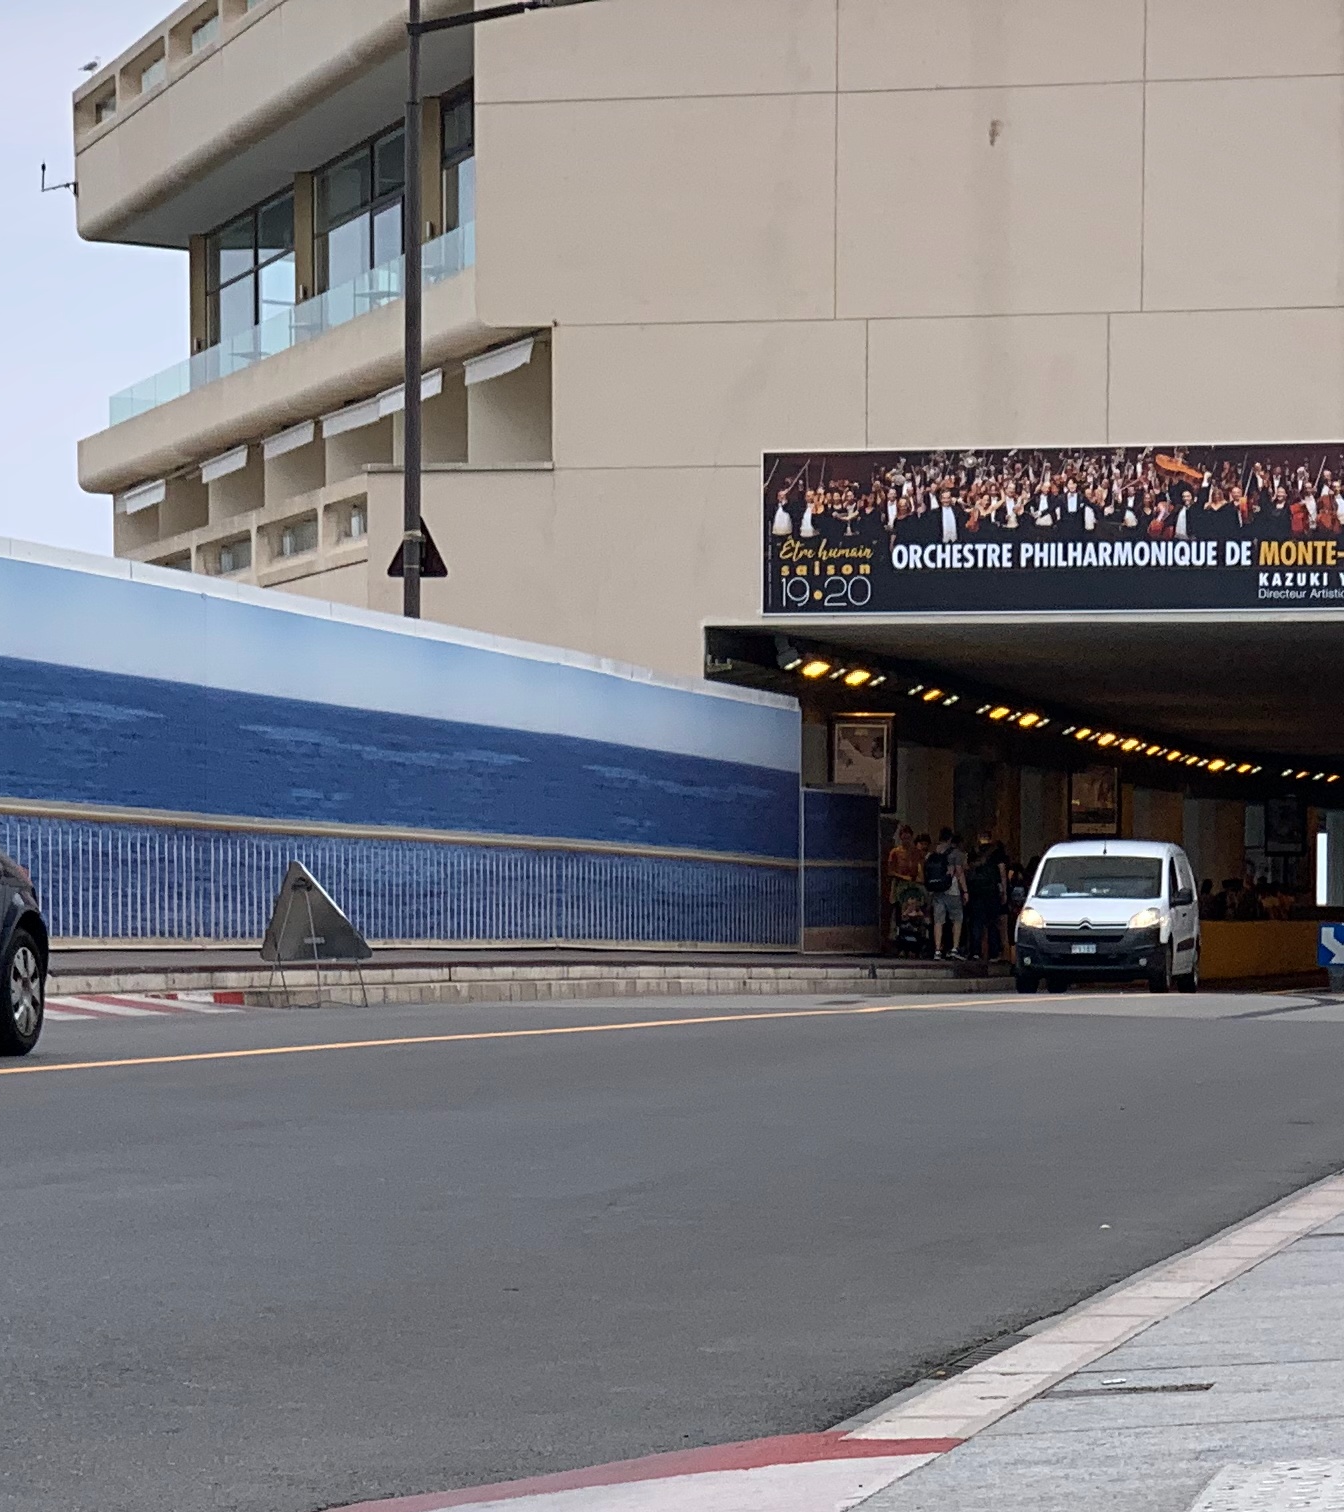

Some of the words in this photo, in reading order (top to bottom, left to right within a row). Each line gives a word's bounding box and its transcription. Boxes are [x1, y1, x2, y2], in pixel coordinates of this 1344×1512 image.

[892, 543, 1013, 570] ORCHESTRE
[1020, 541, 1217, 569] PHILHARMONIQUE
[1225, 541, 1252, 566] DE
[781, 560, 871, 577] saison
[1259, 572, 1329, 587] KAZUKI
[1258, 588, 1307, 600] Directeur
